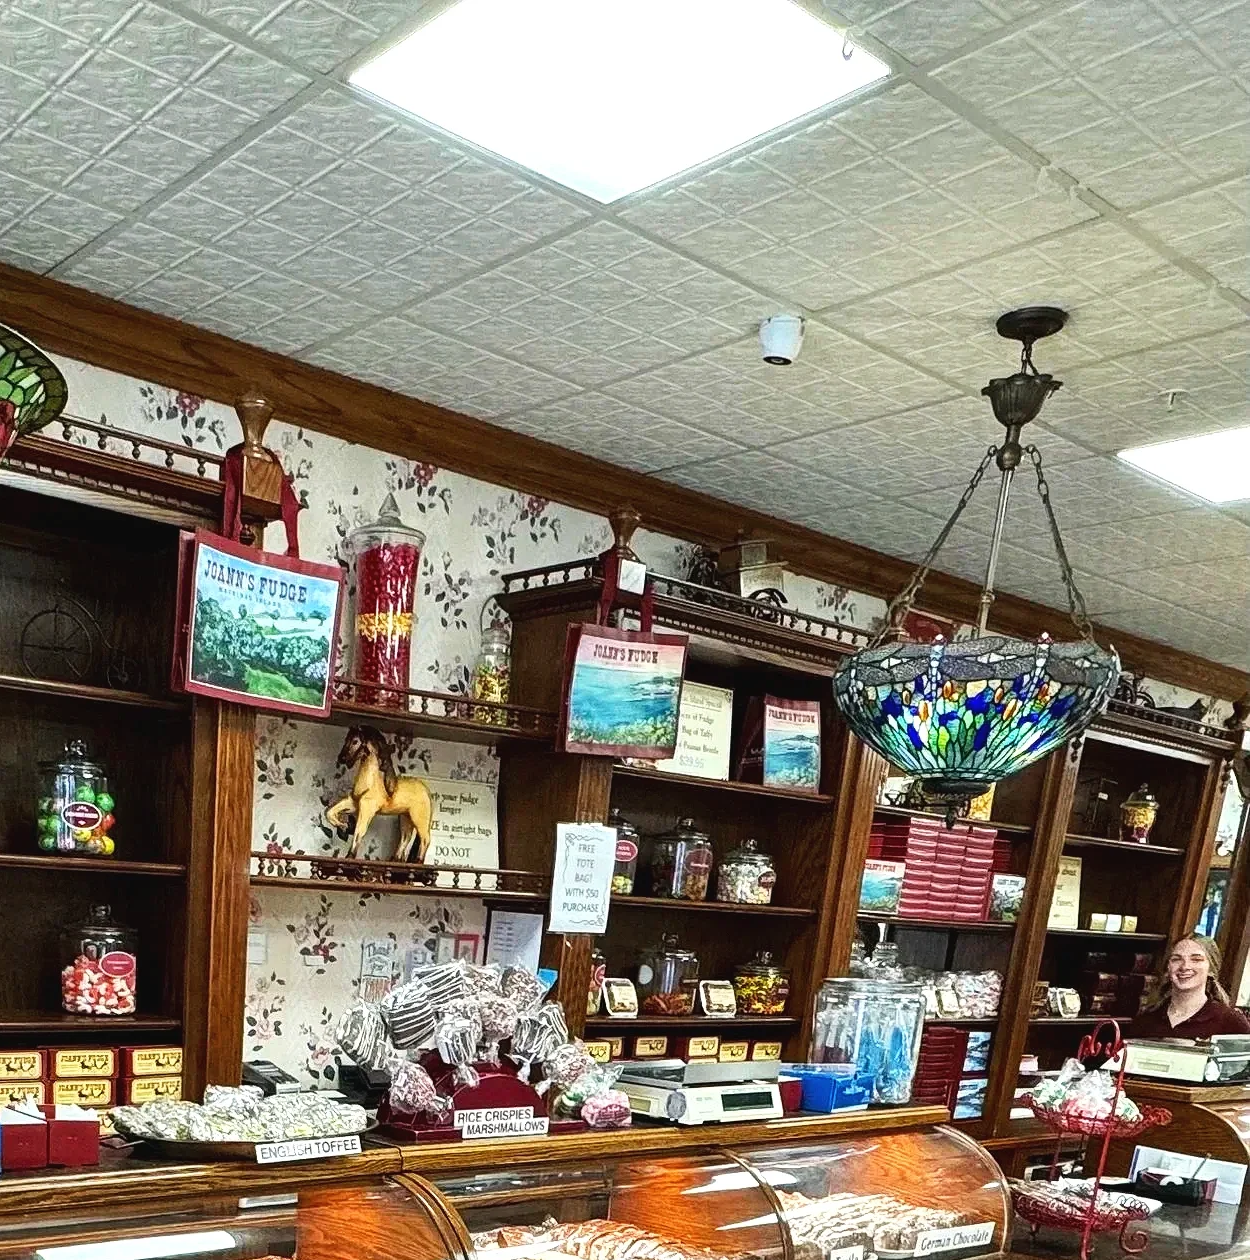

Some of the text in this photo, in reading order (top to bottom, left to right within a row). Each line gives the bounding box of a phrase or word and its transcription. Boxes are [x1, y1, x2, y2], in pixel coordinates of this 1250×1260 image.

[204, 560, 307, 602] JOANN'S FUDGE
[593, 644, 659, 664] JOANN'S FUDGE
[435, 846, 471, 857] DO NOT
[578, 844, 595, 853] FREE
[577, 859, 595, 868] TOTE
[565, 888, 584, 897] WITH
[562, 902, 599, 912] PURCHASE
[457, 1109, 531, 1125] RICE CRISPIES
[466, 1121, 546, 1135] MARSHMALLOWS
[260, 1138, 359, 1159] ENGLISH TOFFEE
[920, 1229, 989, 1251] German Chocolate
